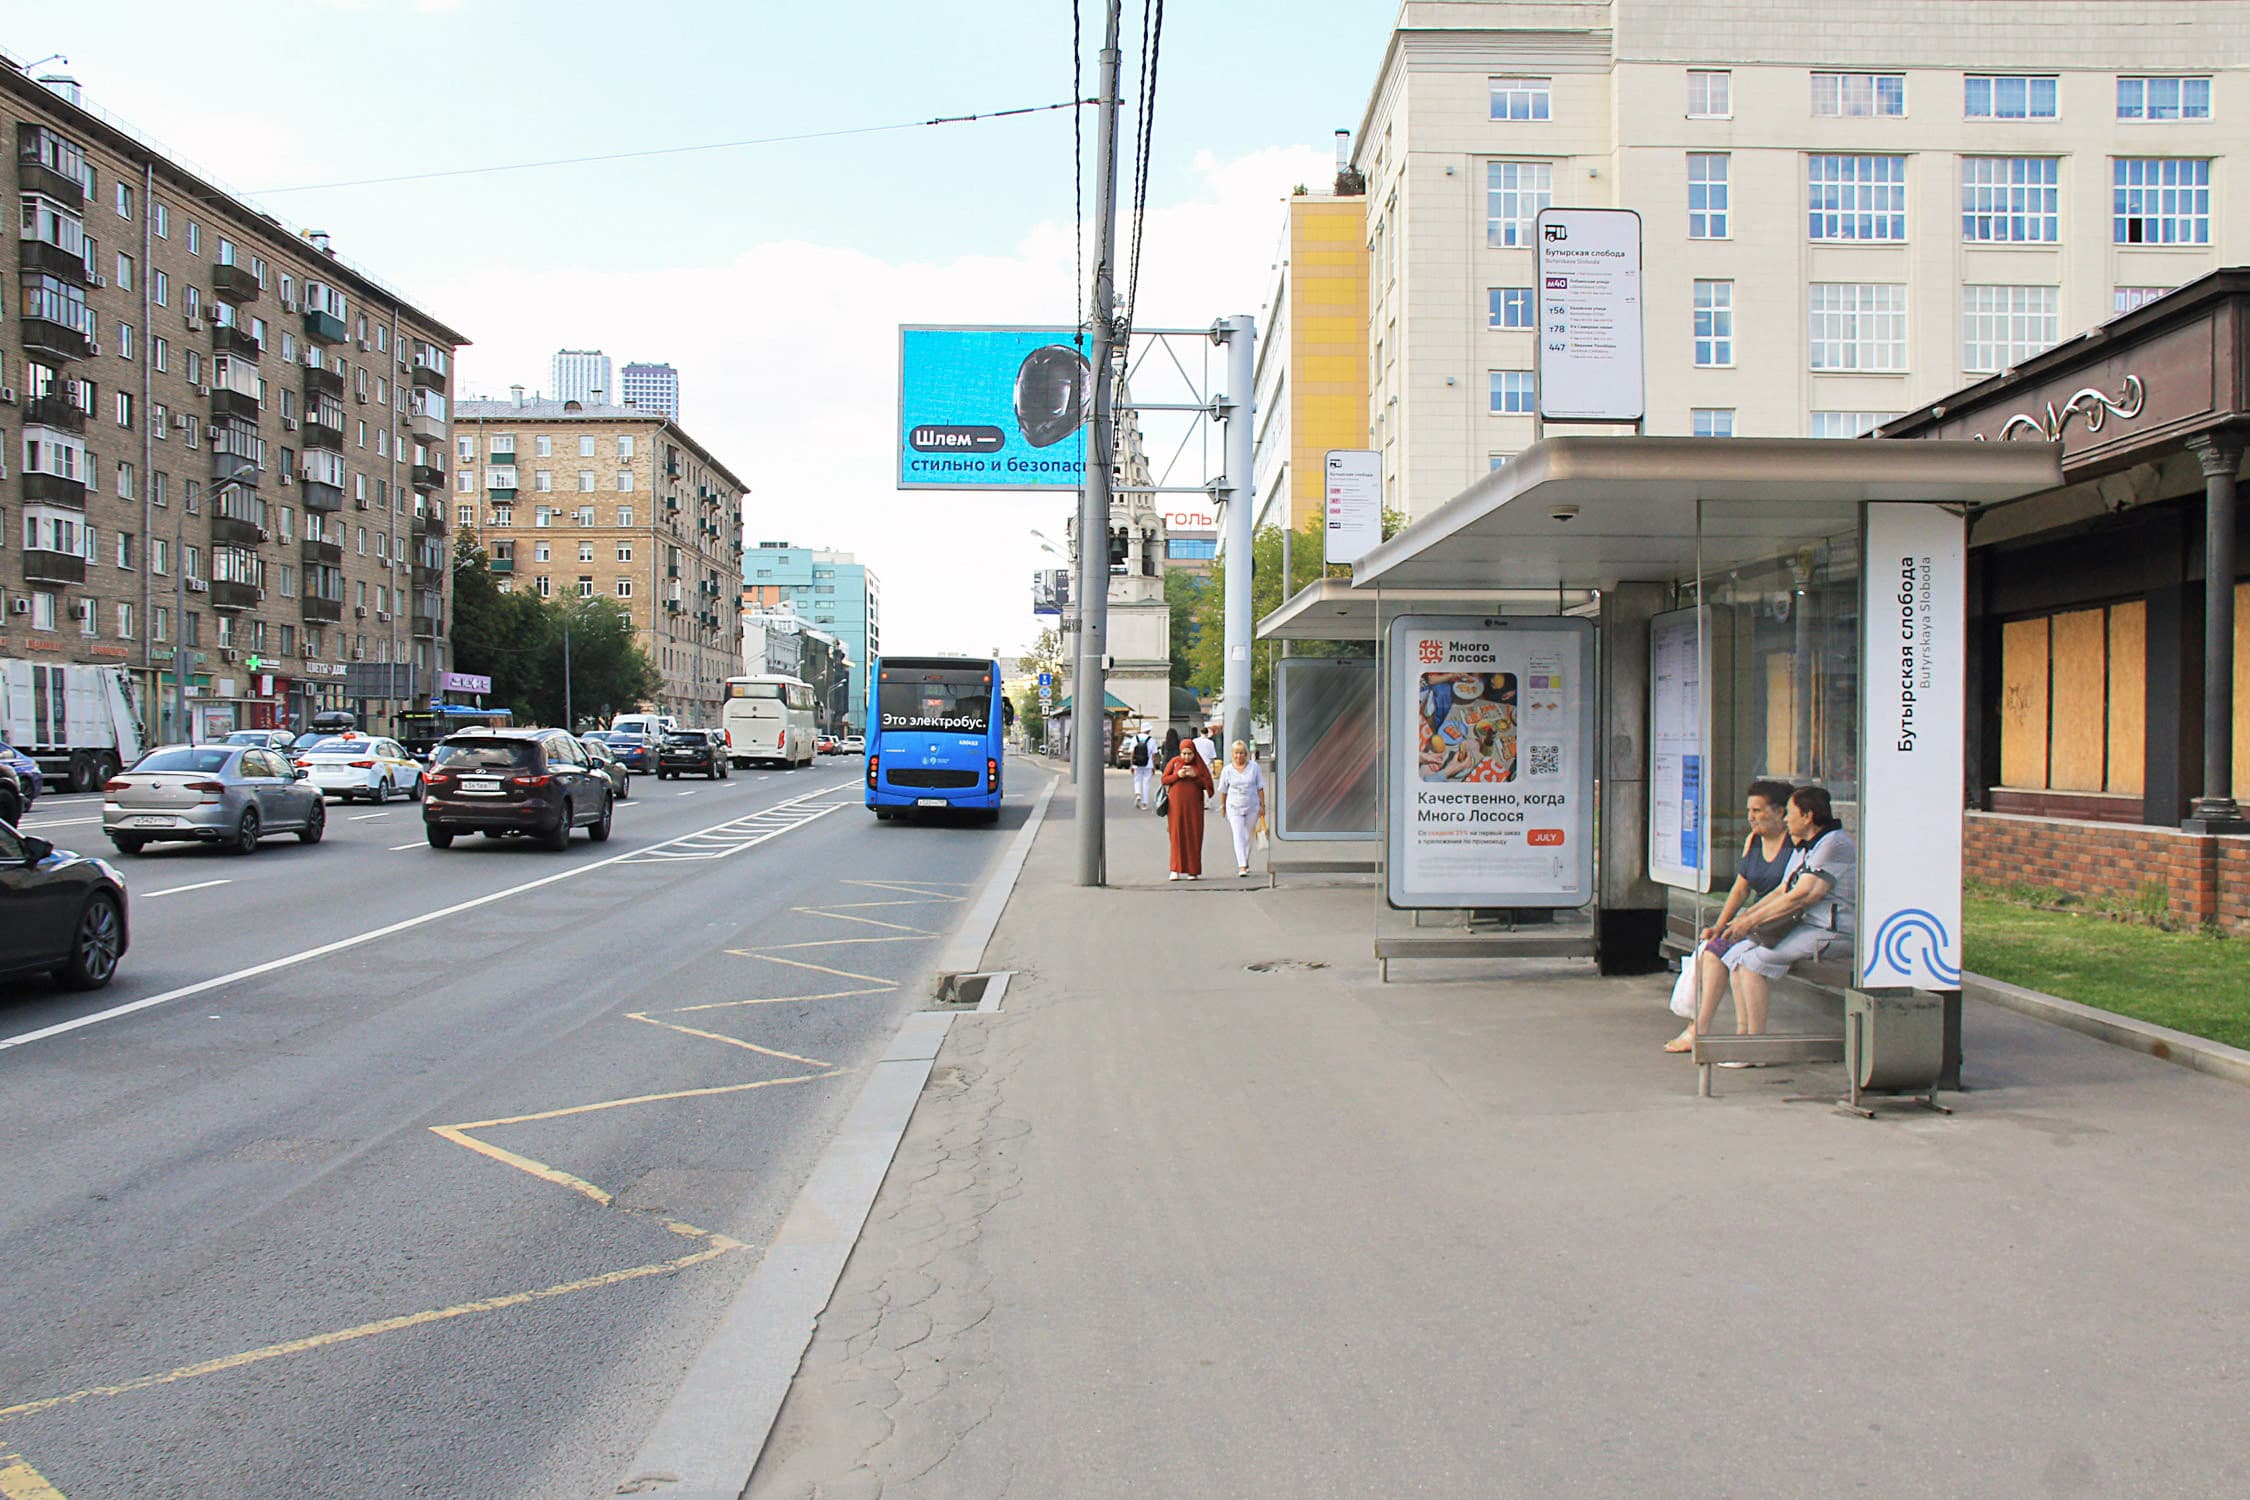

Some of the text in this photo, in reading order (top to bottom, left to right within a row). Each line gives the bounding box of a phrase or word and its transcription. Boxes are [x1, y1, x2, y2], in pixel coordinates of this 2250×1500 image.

[1545, 249, 1625, 259] Бутырская слобода
[1549, 344, 1566, 352] 447
[916, 430, 972, 446] Шлем
[911, 459, 984, 472] стильно
[991, 460, 1001, 471] и
[1920, 557, 1935, 689] Butyrskaya Sloboda
[1449, 641, 1490, 652] Много
[1449, 654, 1496, 663] лосося
[1898, 556, 1917, 752] Бутырская слобода
[883, 714, 986, 729] Это электробус.
[1418, 792, 1565, 807] Качественно, когда
[1418, 810, 1524, 822] Много Лосося
[1535, 833, 1556, 843] JULY
